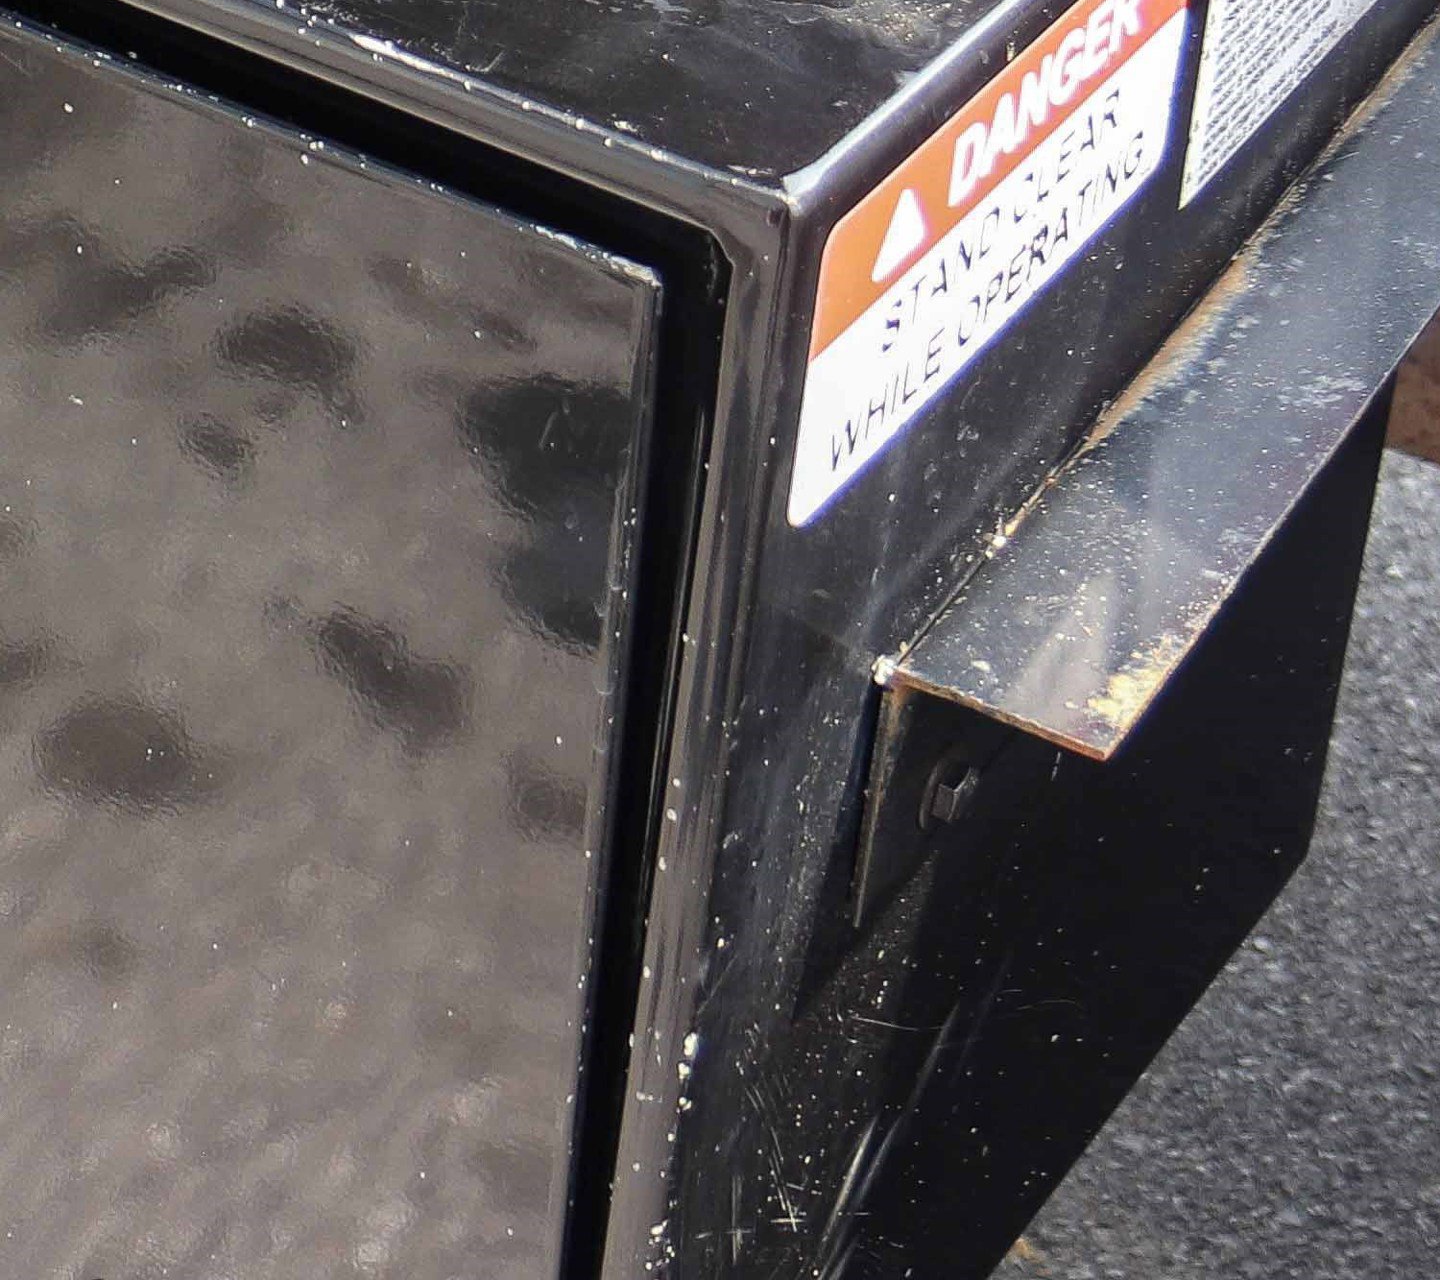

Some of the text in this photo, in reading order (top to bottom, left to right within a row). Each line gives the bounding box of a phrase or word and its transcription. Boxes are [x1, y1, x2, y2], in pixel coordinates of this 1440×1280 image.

[831, 129, 1145, 472] WHILE OPERATING
[881, 88, 1120, 354] STAND CLEAR
